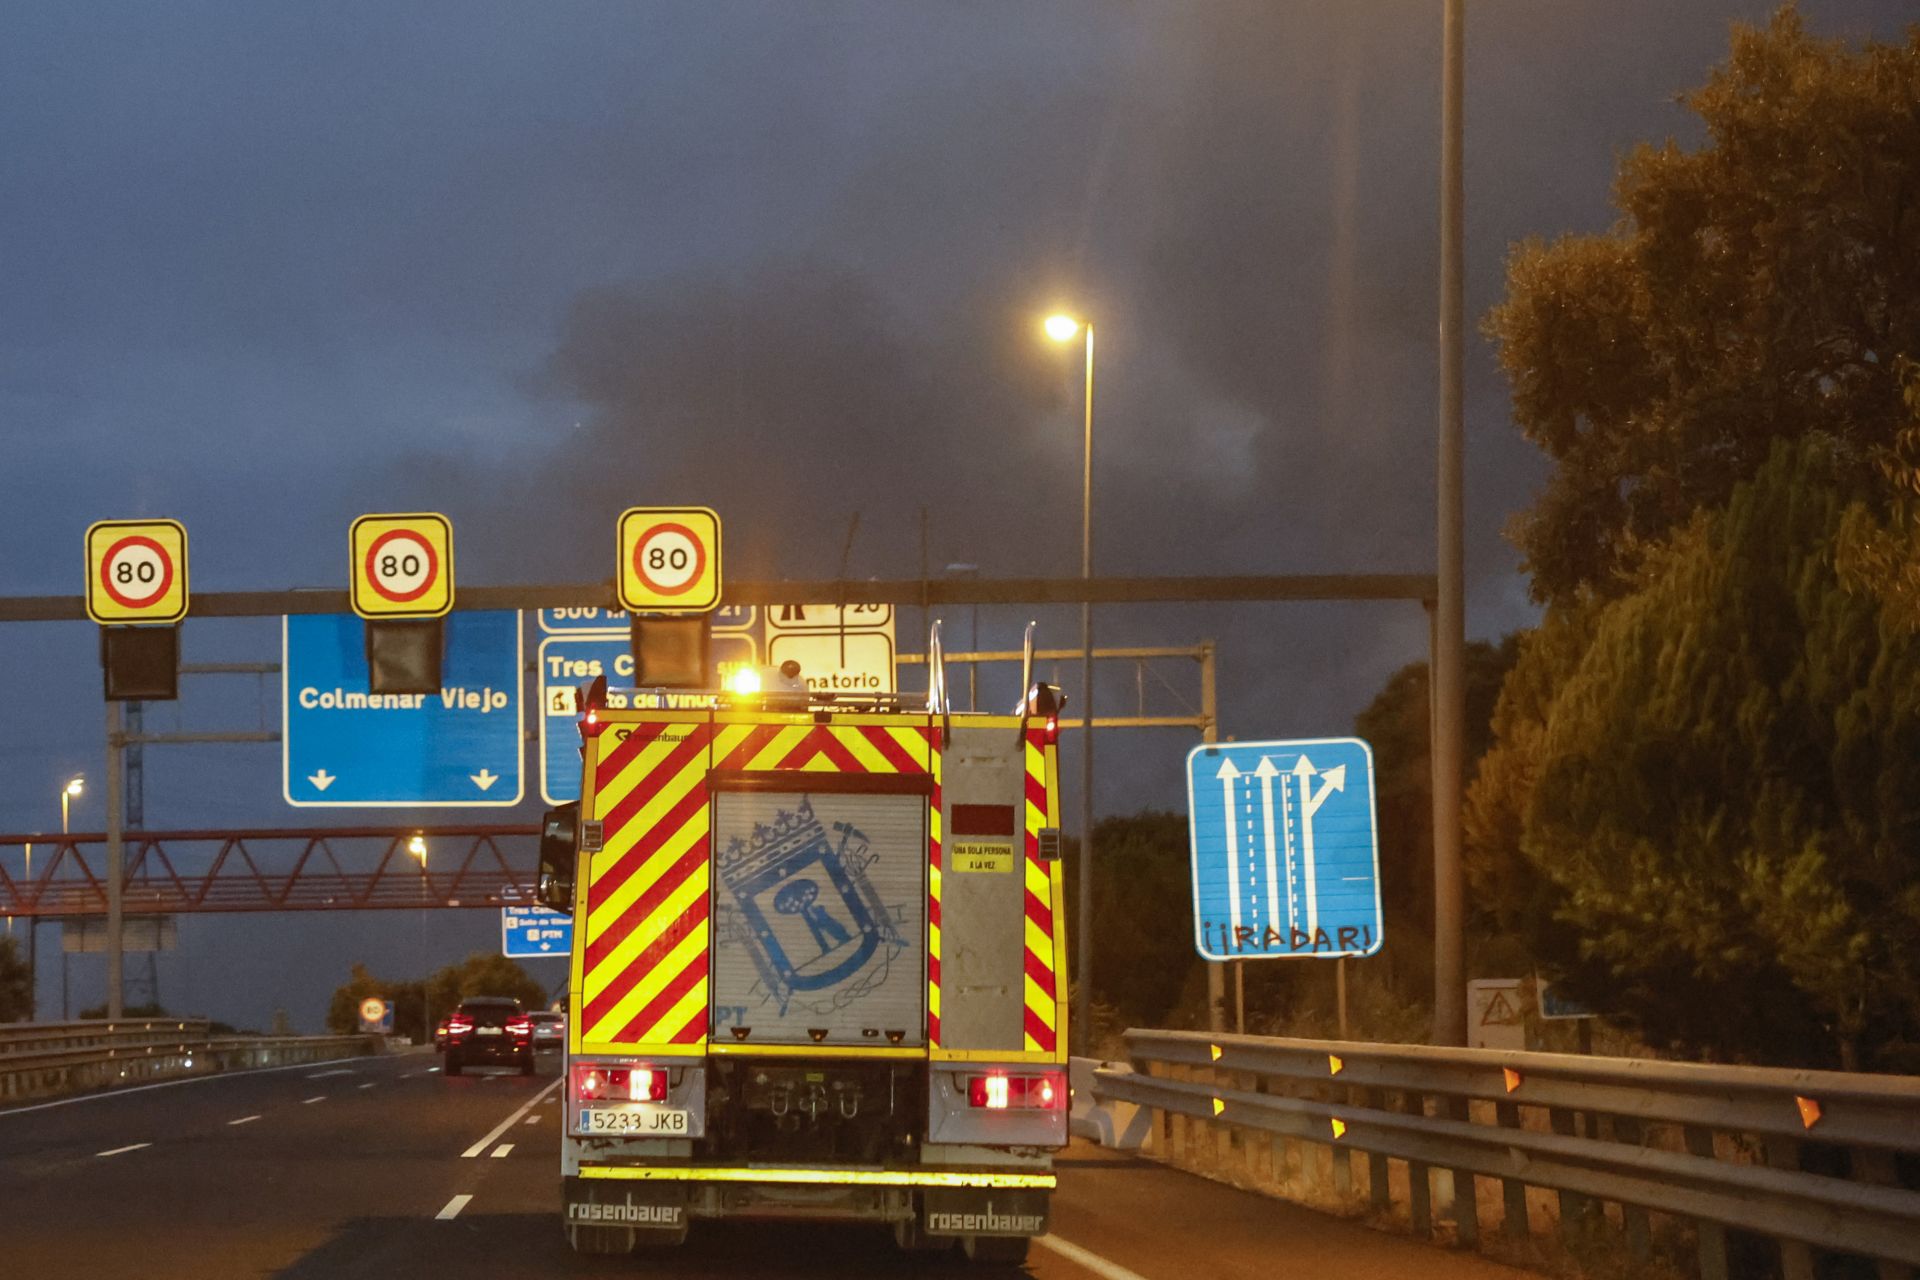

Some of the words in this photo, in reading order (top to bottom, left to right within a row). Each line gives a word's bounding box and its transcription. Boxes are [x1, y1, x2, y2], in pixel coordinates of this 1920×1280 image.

[382, 555, 420, 577] 80
[649, 548, 687, 570] 80
[117, 561, 155, 584] 80
[547, 656, 603, 677] Tres
[806, 674, 880, 689] natorio
[299, 687, 426, 709] Colmenar
[441, 687, 508, 713] Viejo
[984, 847, 1011, 855] PERSONA
[594, 1112, 641, 1129] 5233
[649, 1113, 684, 1130] JKB
[569, 1192, 682, 1222] rosenbauer
[930, 1201, 1044, 1231] rosenbauer
